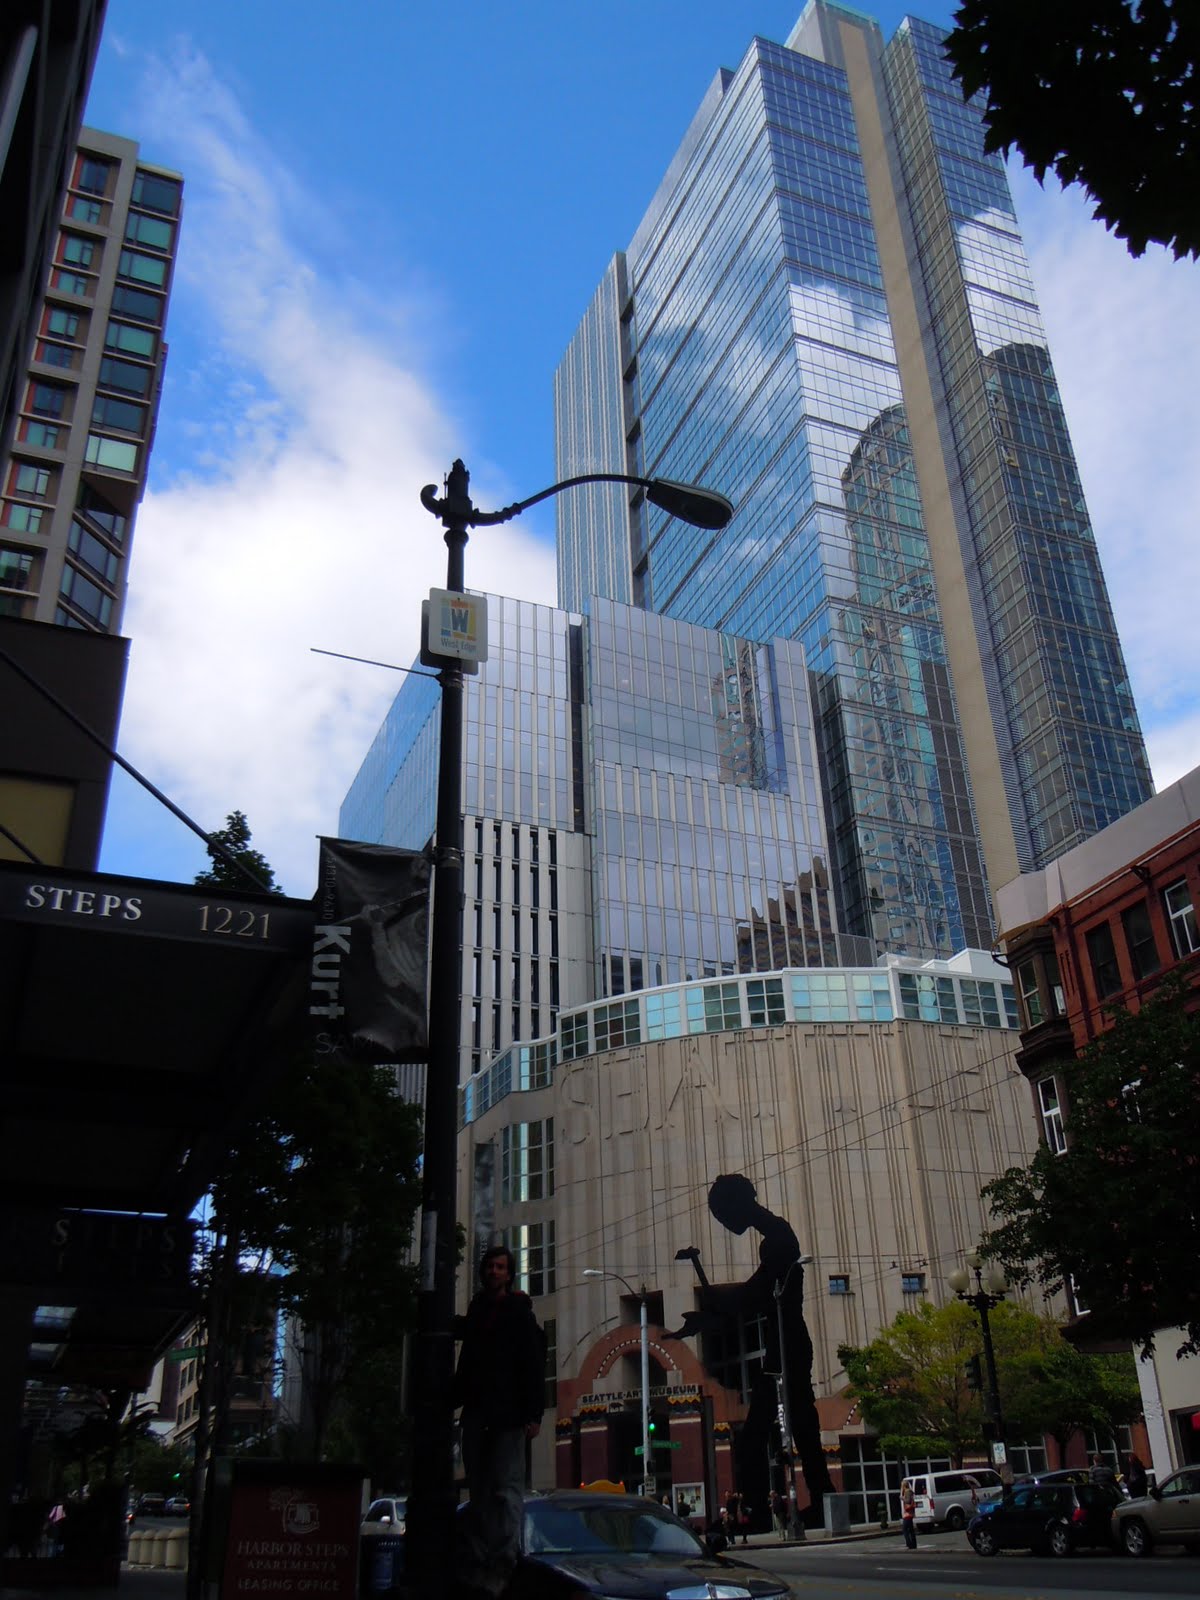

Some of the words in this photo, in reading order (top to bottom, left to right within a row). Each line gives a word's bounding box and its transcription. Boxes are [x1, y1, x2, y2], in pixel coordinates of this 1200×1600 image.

[451, 608, 469, 633] W
[26, 884, 142, 921] STEPS
[199, 904, 271, 939] 1221
[309, 924, 352, 1020] Kurt
[582, 1391, 623, 1404] SEATTLE
[649, 1384, 696, 1396] MUSEUM
[237, 1541, 303, 1557] HARBOR
[305, 1542, 350, 1557] STEPS
[247, 1560, 337, 1570] APARTMENTS
[238, 1578, 293, 1592] LEASING
[297, 1578, 341, 1592] OFFICE
